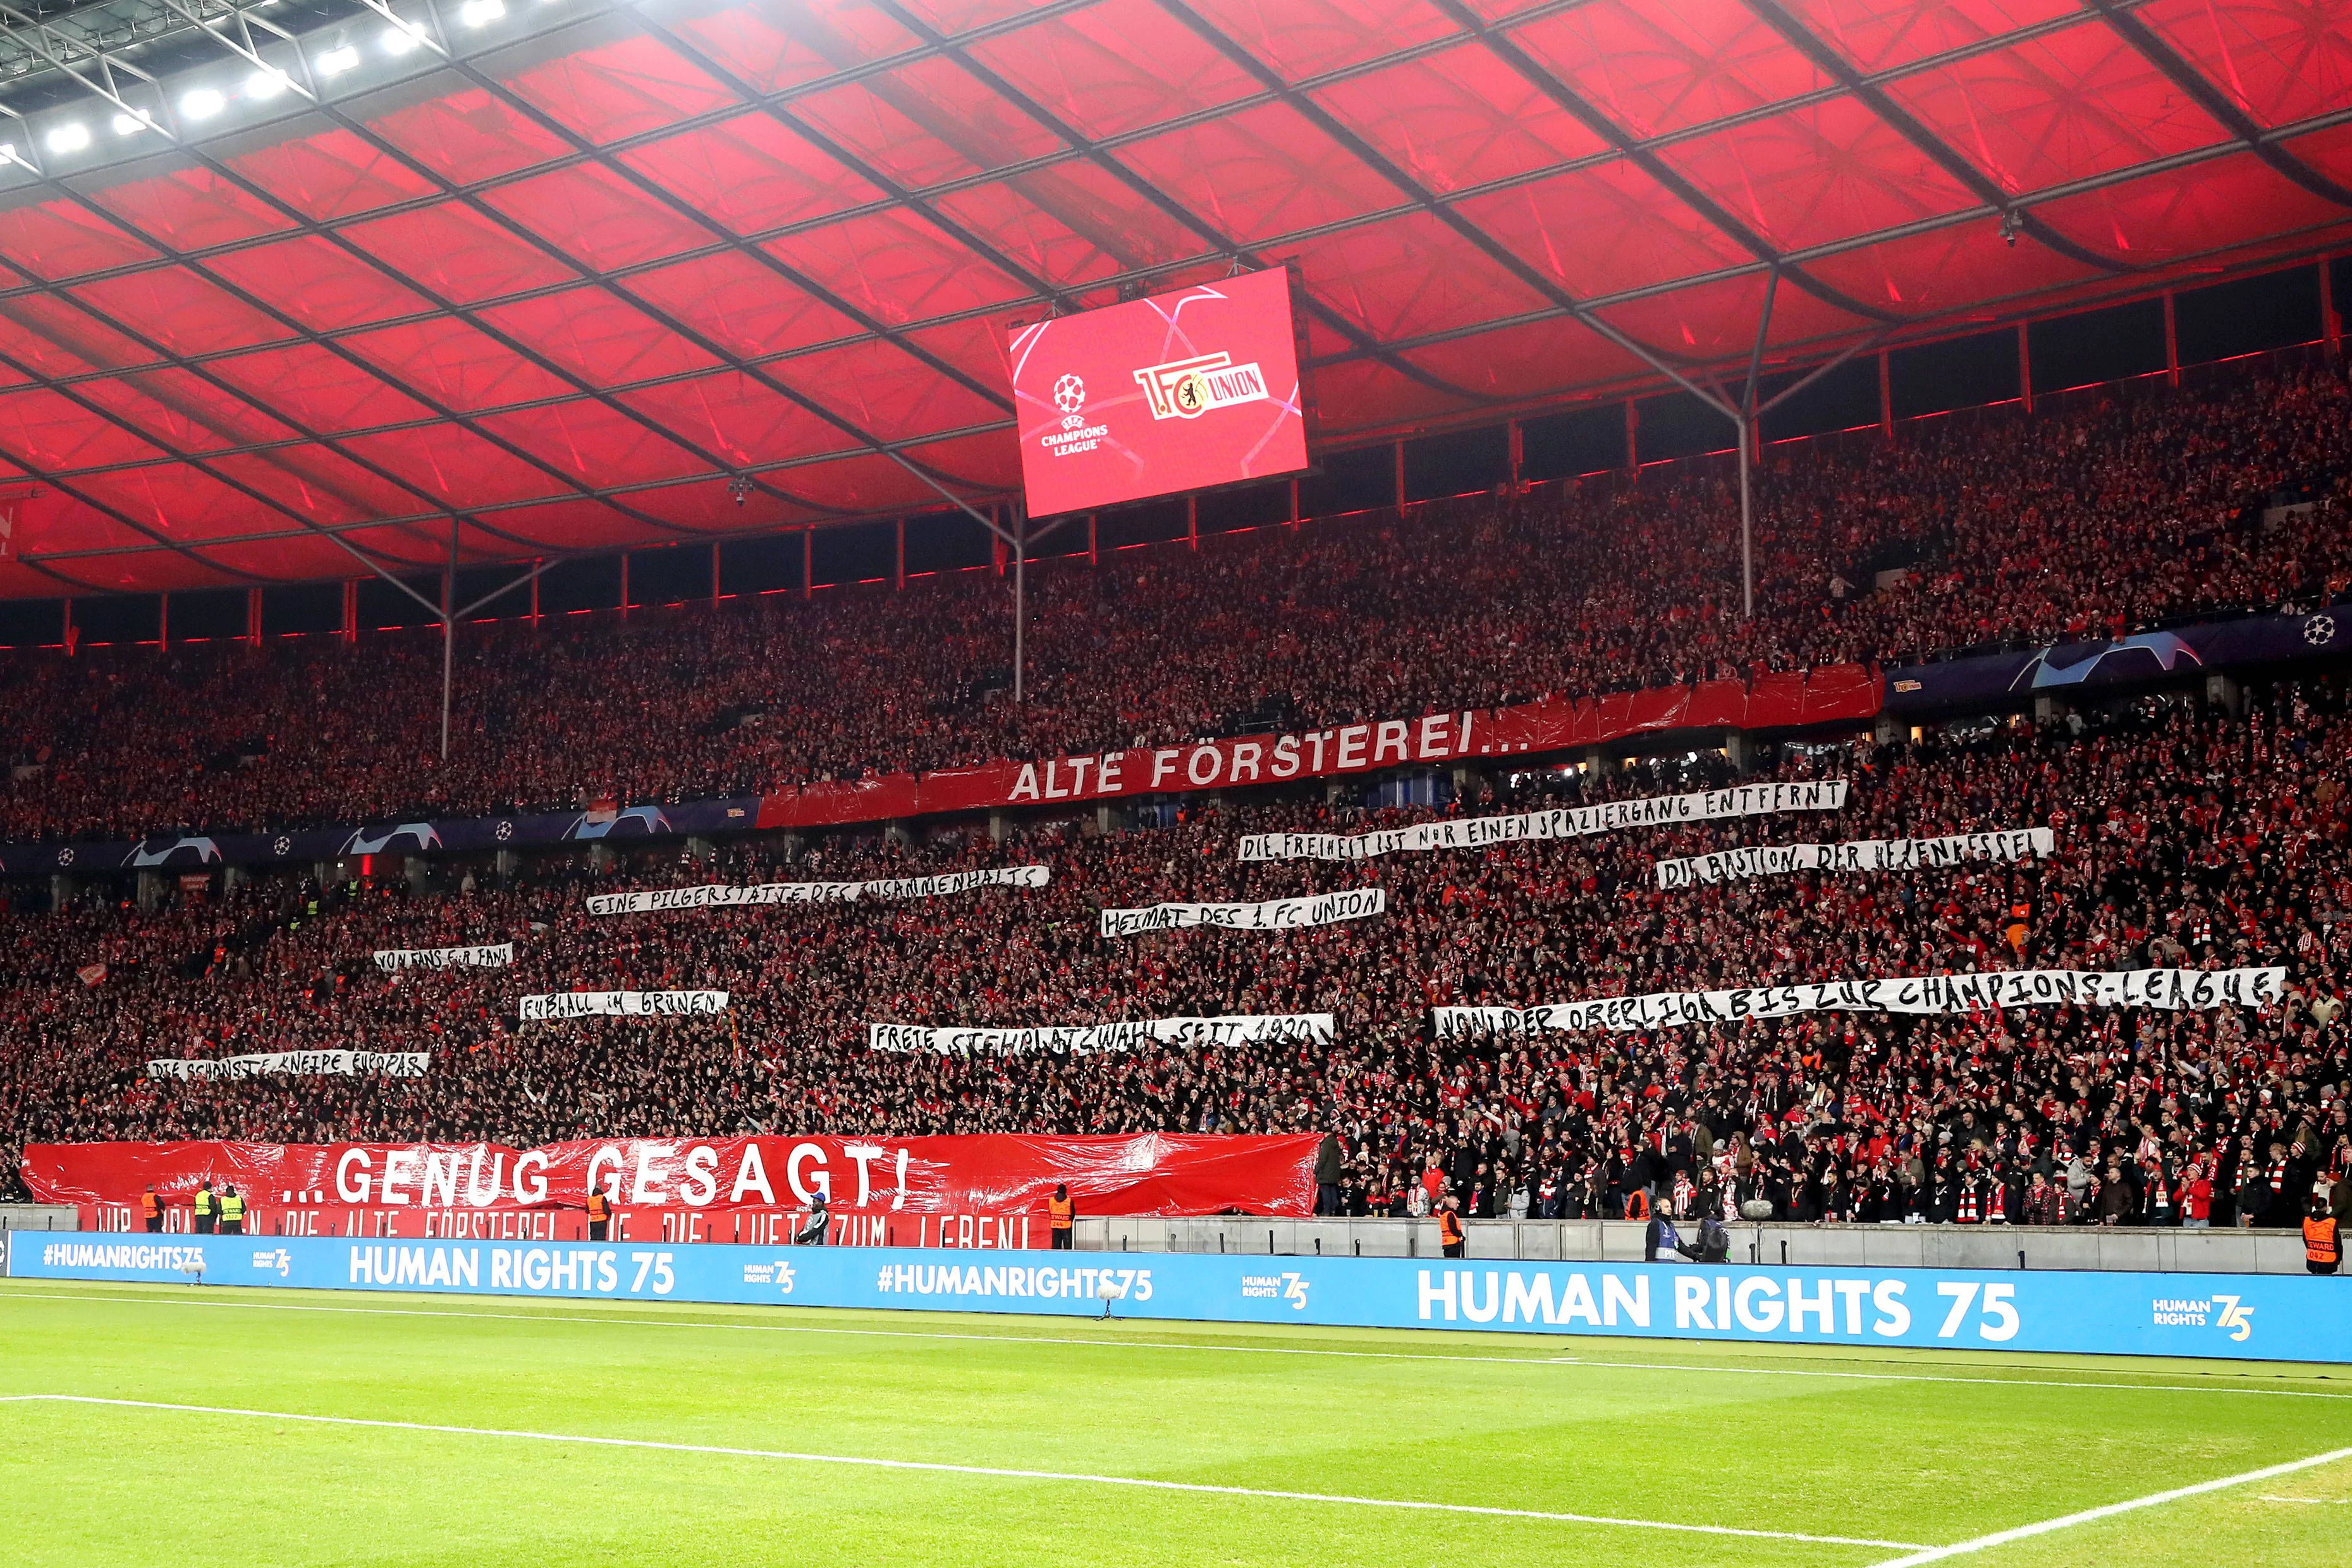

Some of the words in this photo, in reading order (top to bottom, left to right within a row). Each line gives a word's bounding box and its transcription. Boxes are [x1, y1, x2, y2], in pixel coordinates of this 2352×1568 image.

[1208, 369, 1261, 401] UNION
[1041, 424, 1108, 446] CHAMPIONS
[1054, 439, 1098, 456] LEAGUE
[1008, 752, 1123, 800] ALTE
[1244, 838, 1273, 858] DIE
[1284, 835, 1369, 858] FREIHEIT
[1377, 832, 1407, 852] IST
[1419, 824, 1454, 846] NUR
[1468, 814, 1529, 843] EINEN
[1540, 797, 1691, 838] SPAZIERGANG
[1706, 781, 1841, 814] ENTFERNT
[1665, 858, 1696, 884] DIE
[1818, 843, 1859, 870] DER
[592, 894, 641, 912] EINE
[1105, 908, 1189, 935] HEIMAT
[1201, 908, 1241, 924] DES
[1253, 905, 1266, 928] 1.
[1274, 903, 1302, 924] FC
[1312, 890, 1378, 924] UNION
[379, 952, 406, 969] VON
[411, 950, 442, 968] FANS
[478, 948, 506, 965] FANS
[1730, 986, 1801, 1017] BIS
[1811, 979, 1886, 1011] ZUR
[1899, 971, 2270, 1008] CHAMPIONS-LEAGUE
[876, 1025, 937, 1051] FREIE
[1177, 1022, 1243, 1044] SEIT
[587, 1142, 909, 1210] GESAGT!
[254, 1251, 276, 1259] HUMAN
[254, 1259, 273, 1268] RIGHTS
[274, 1249, 292, 1277] 75
[350, 1246, 479, 1287] HUMAN
[491, 1248, 618, 1292] RIGHTS
[630, 1251, 675, 1295] 75
[744, 1264, 775, 1275] HUMAN
[744, 1274, 771, 1284] RIGHTS
[774, 1261, 796, 1294] 75
[1242, 1276, 1281, 1287] HUMAN
[1242, 1287, 1278, 1298] RIGHTS
[1282, 1272, 1311, 1311] 75
[1418, 1270, 1651, 1327] HUMAN
[1675, 1276, 1912, 1337] RIGHTS
[1937, 1281, 2021, 1342] 75
[2153, 1299, 2212, 1313] HUMAN
[2153, 1313, 2207, 1326] RIGHTS
[2212, 1294, 2255, 1342] 75
